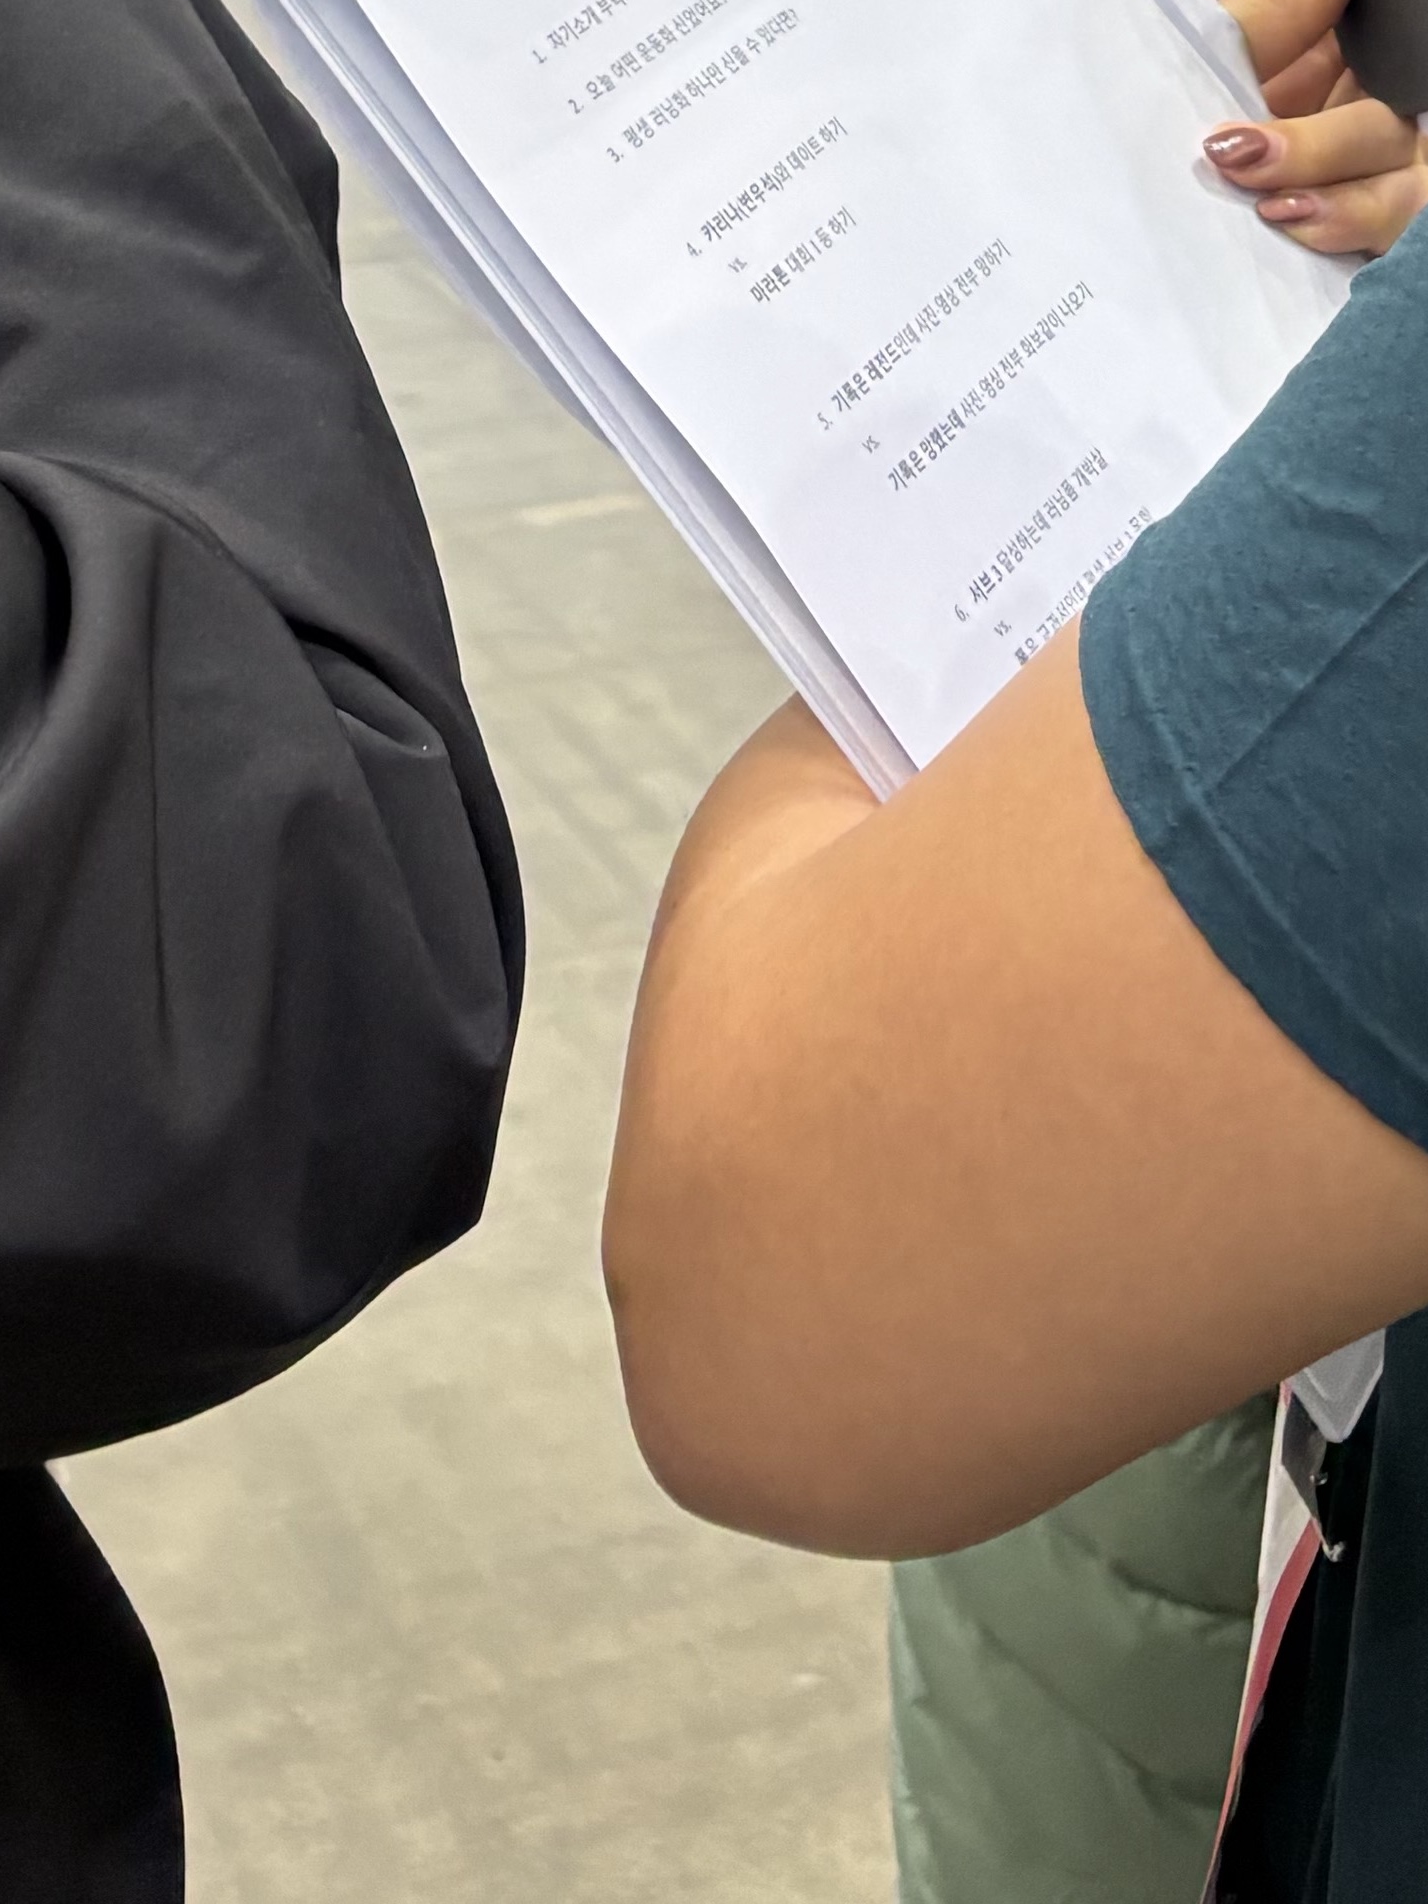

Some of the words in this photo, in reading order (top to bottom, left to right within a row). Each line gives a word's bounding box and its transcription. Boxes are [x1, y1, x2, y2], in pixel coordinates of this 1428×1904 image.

[531, 48, 548, 65] 1.
[545, 4, 603, 50] 자기소개
[566, 97, 585, 115] 2.
[584, 73, 616, 101] 오늘
[634, 23, 678, 63] 운동화
[605, 146, 625, 164] 3.
[621, 116, 655, 149] 평생
[684, 61, 727, 98] 하나만
[719, 43, 751, 75] 신을
[745, 36, 761, 54] 수
[685, 241, 703, 257] 4.
[784, 134, 825, 171] 데이트
[817, 114, 849, 143] 하기
[748, 263, 791, 303] 마라톤
[783, 241, 816, 273] 대회
[826, 204, 857, 235] 하기
[815, 410, 834, 431] 5.
[829, 371, 871, 413] 기록은
[951, 265, 980, 297] 전부
[972, 236, 1012, 278] 망하기
[886, 449, 927, 492] 기록은
[997, 346, 1025, 379] 전부
[1056, 279, 1094, 317] 나오기
[953, 602, 970, 622] 6.
[994, 508, 1052, 574] 달성하는데
[1041, 477, 1079, 520] 러닝폼
[1069, 446, 1109, 487] 개박살
